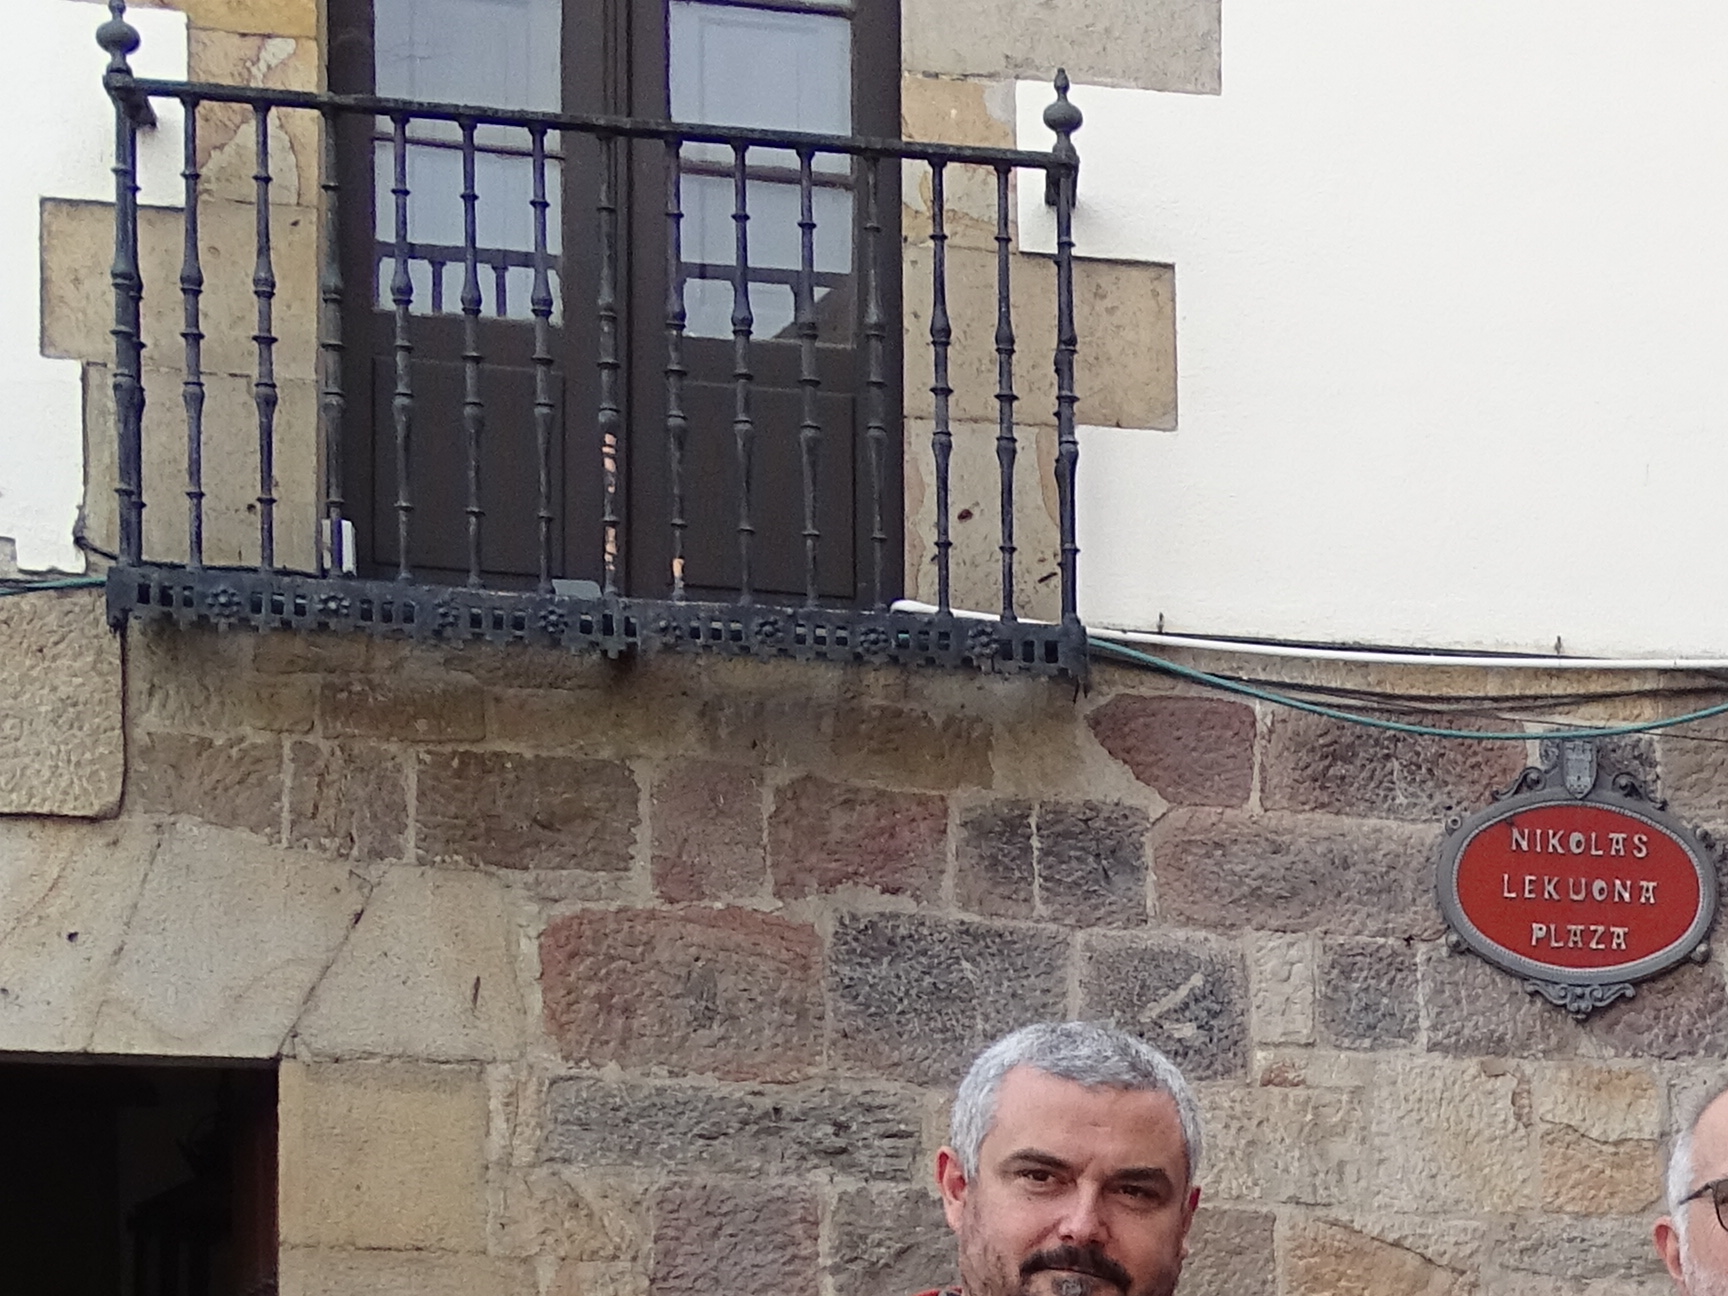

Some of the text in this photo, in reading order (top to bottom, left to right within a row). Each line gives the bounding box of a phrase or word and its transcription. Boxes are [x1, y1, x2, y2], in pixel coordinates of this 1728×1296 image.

[1510, 827, 1649, 858] NIKOLAS
[1503, 873, 1658, 904] LEKUONA
[1531, 923, 1629, 950] PLAZA
